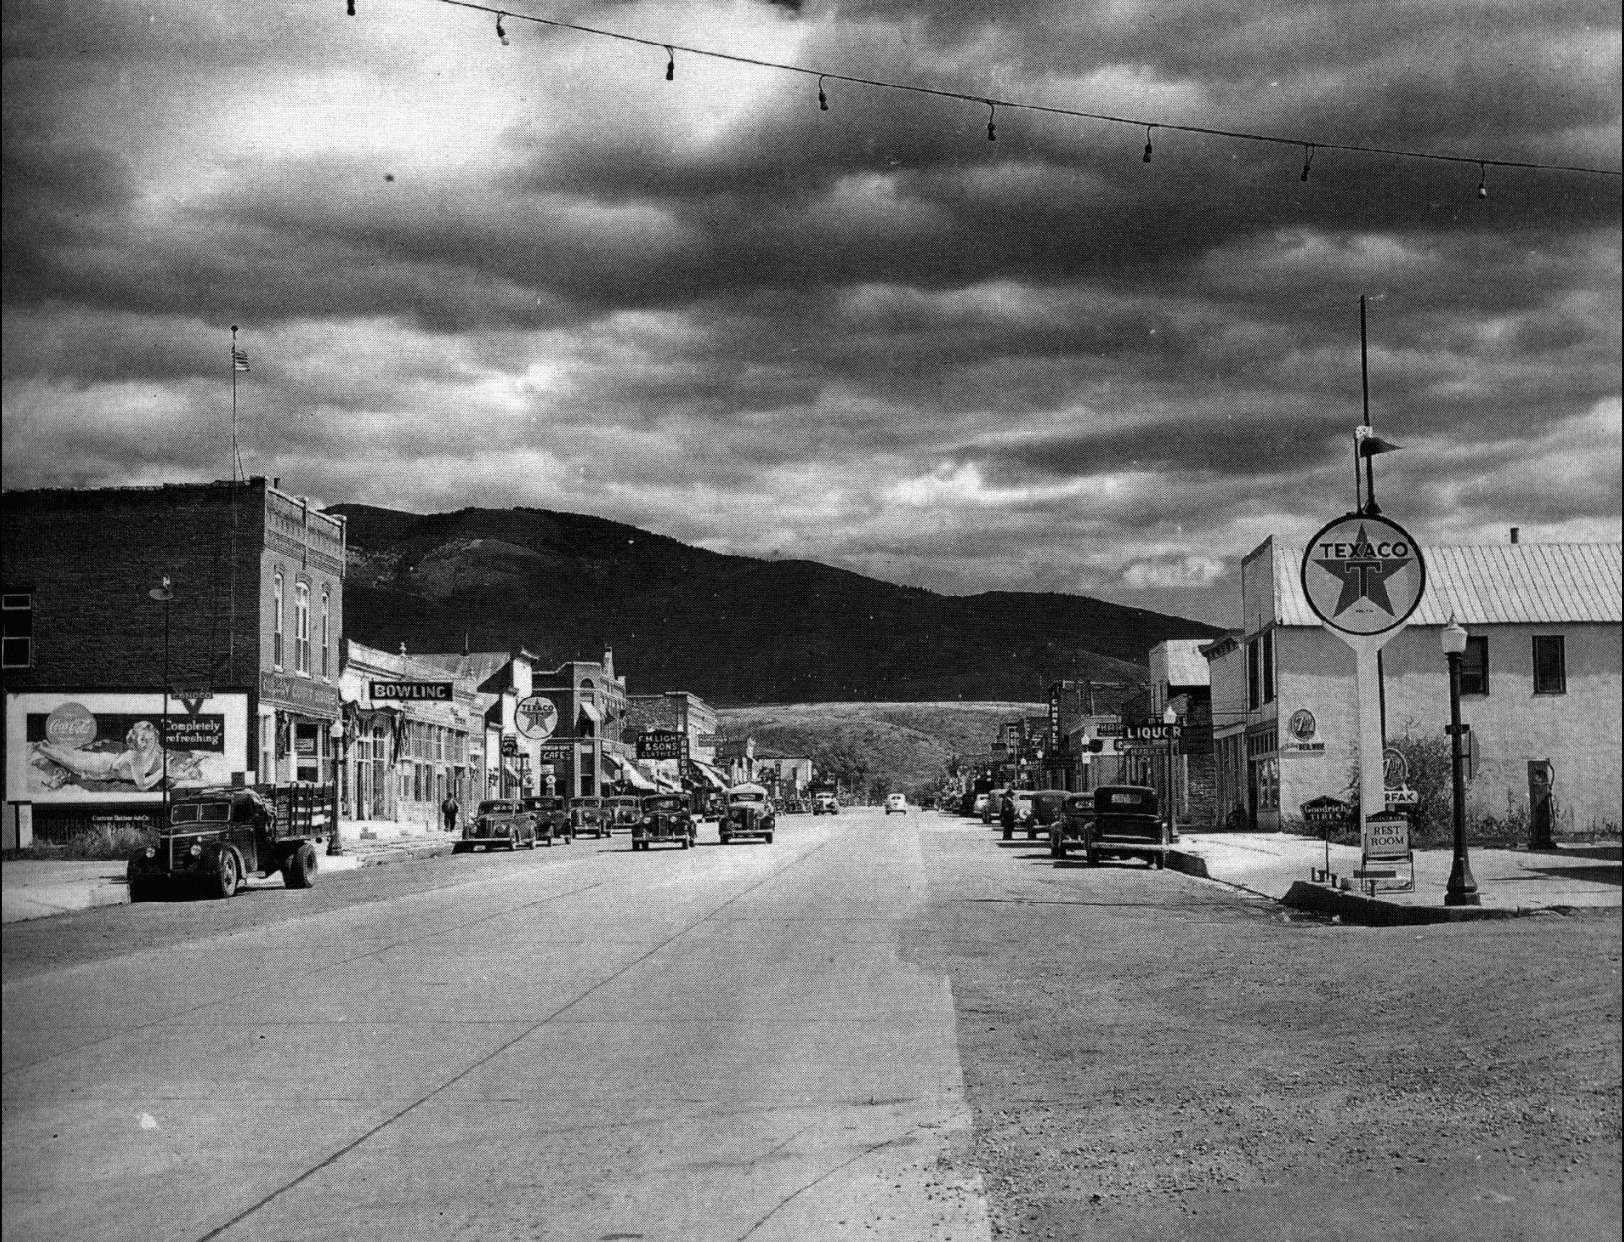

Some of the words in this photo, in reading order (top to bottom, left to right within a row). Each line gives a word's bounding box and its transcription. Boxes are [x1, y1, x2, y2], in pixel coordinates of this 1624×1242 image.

[1319, 541, 1408, 558] TEXACO
[172, 691, 212, 699] CONOCO
[522, 704, 554, 712] TEXACO
[1127, 725, 1181, 740] LIQUOR
[652, 742, 678, 751] SONS
[543, 751, 566, 760] CAFE
[1384, 792, 1415, 802] RFAK
[1304, 803, 1348, 813] Goodrich
[1311, 812, 1342, 820] TIRES
[1373, 825, 1401, 836] REST
[1371, 836, 1405, 847] ROOM
